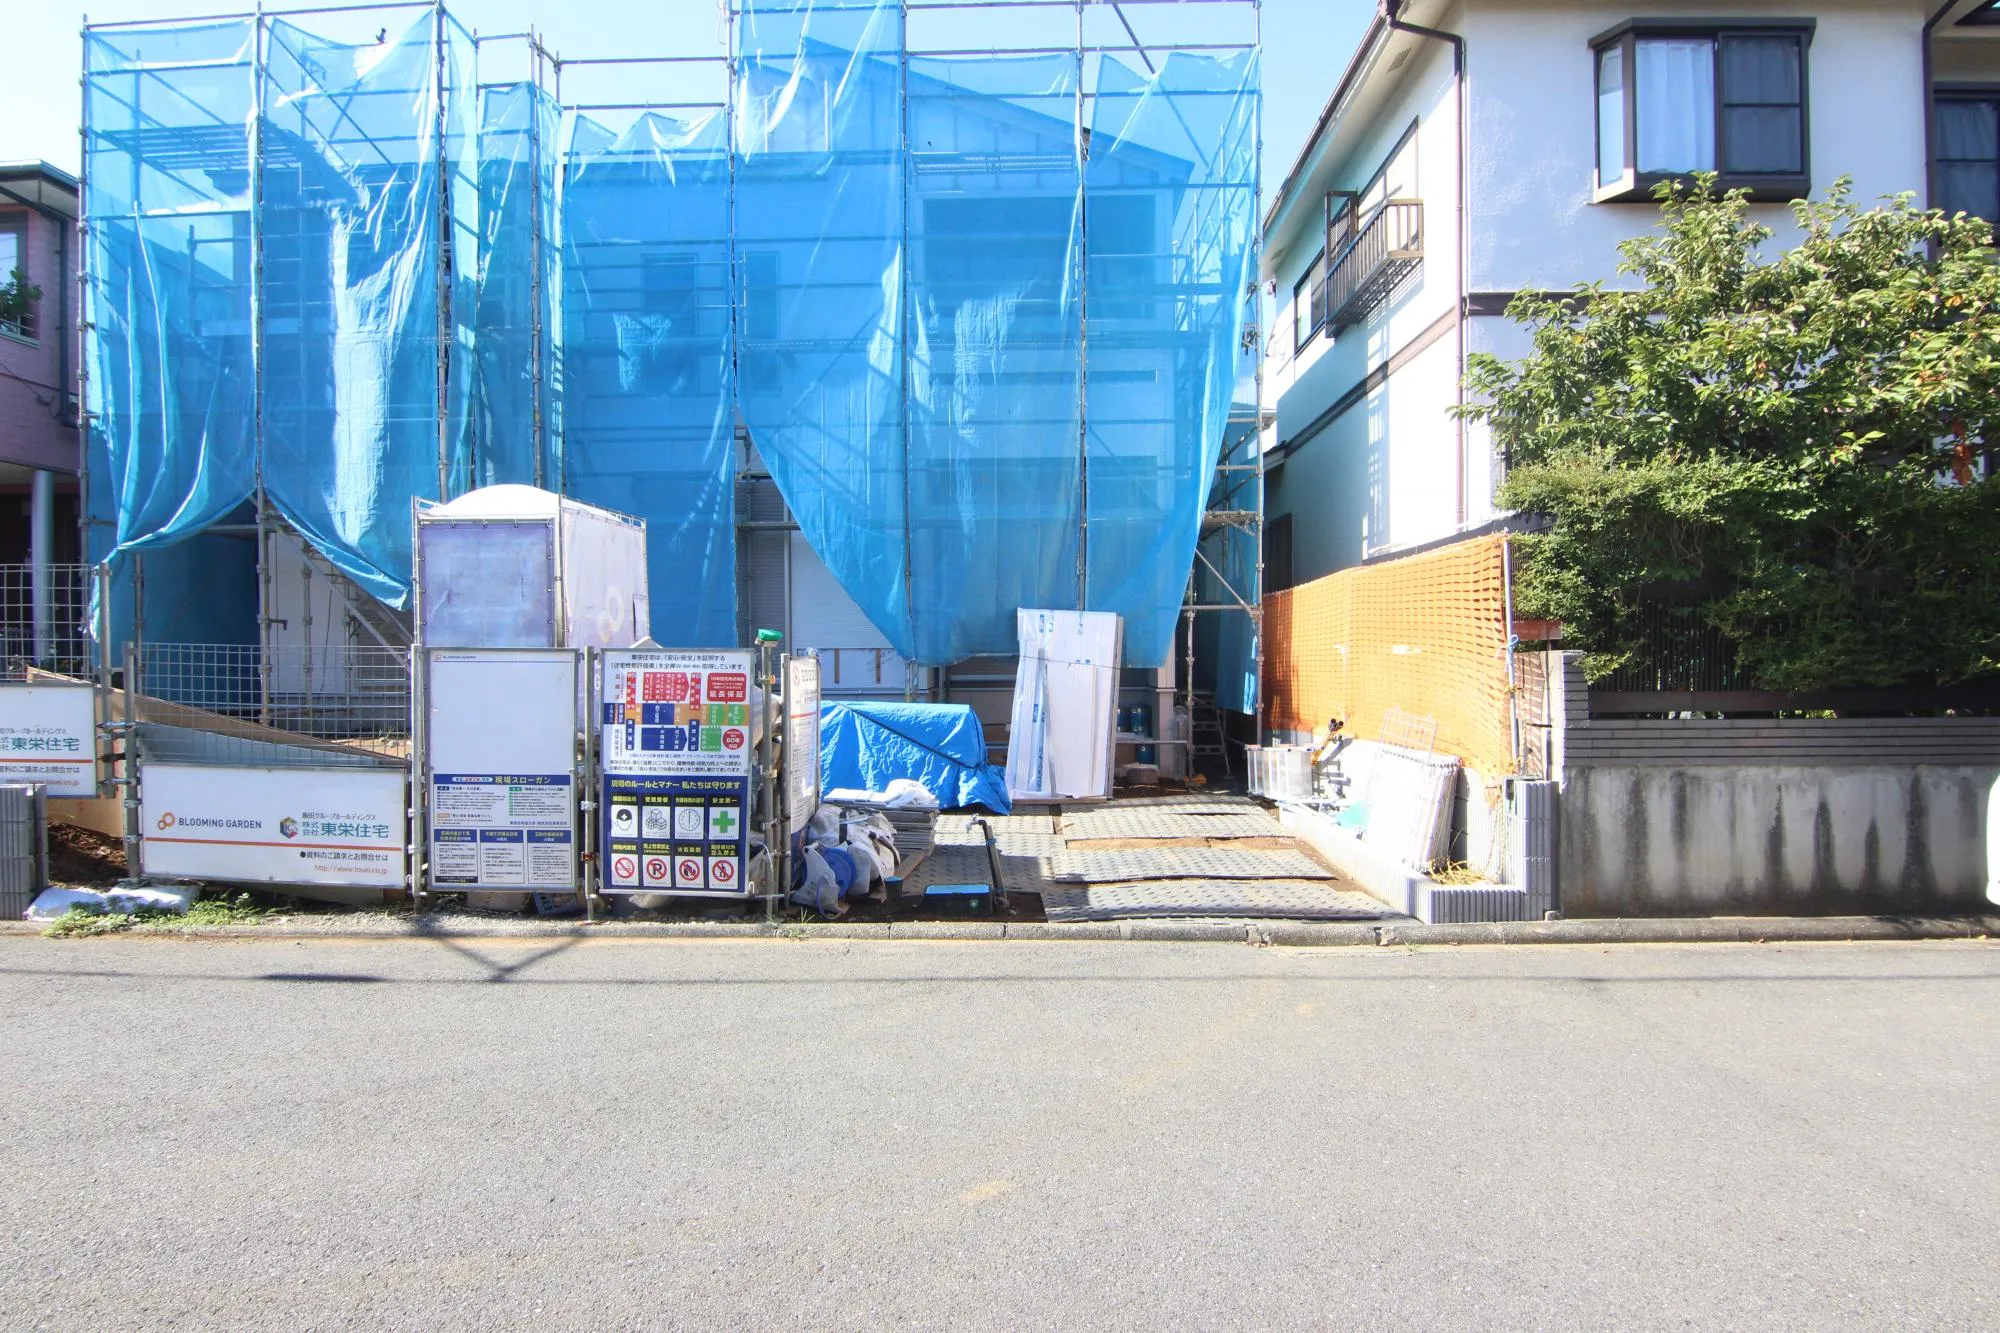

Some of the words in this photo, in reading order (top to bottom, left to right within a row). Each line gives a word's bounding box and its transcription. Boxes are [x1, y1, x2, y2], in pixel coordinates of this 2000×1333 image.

[10, 736, 80, 752] 東栄住宅
[495, 775, 552, 784] 現場スローガン
[682, 781, 741, 790] 私たちは守ります
[178, 817, 224, 828] BLOOMING
[225, 819, 262, 829] GARDEN
[302, 821, 319, 829] 株式
[320, 822, 389, 839] 東栄住宅
